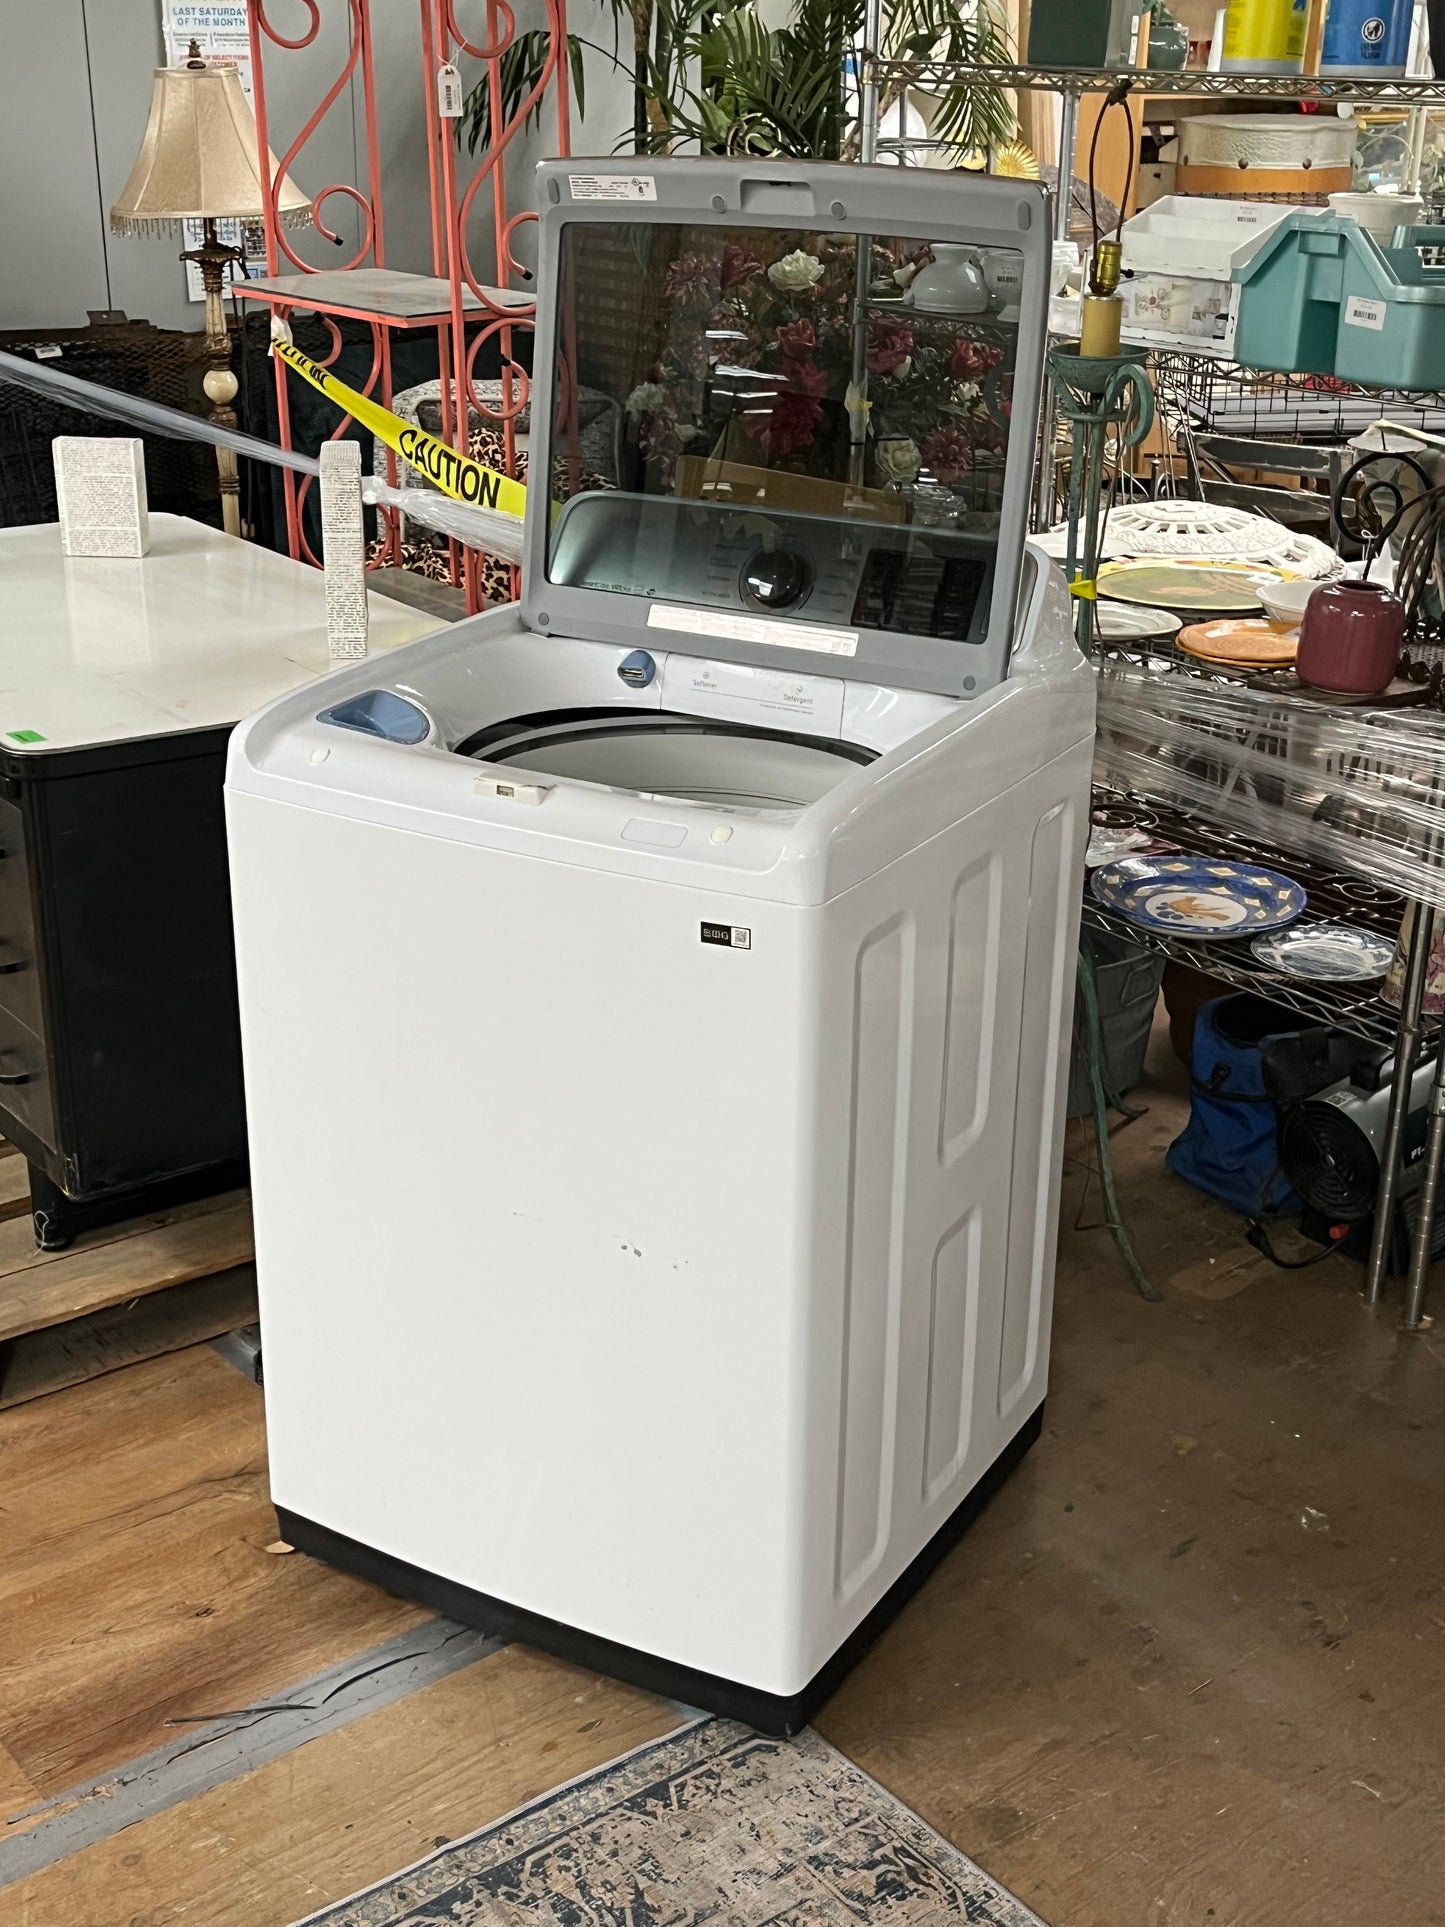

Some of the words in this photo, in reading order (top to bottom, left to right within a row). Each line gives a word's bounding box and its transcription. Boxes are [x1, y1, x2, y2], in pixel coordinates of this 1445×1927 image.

[173, 7, 196, 16] LAST
[199, 7, 247, 16] SATURDAY
[177, 18, 189, 26] OF
[193, 18, 210, 26] THE
[213, 18, 246, 27] MONTH
[399, 429, 501, 509] CAUTION
[693, 679, 718, 689] Softener
[783, 694, 813, 705] Detergent
